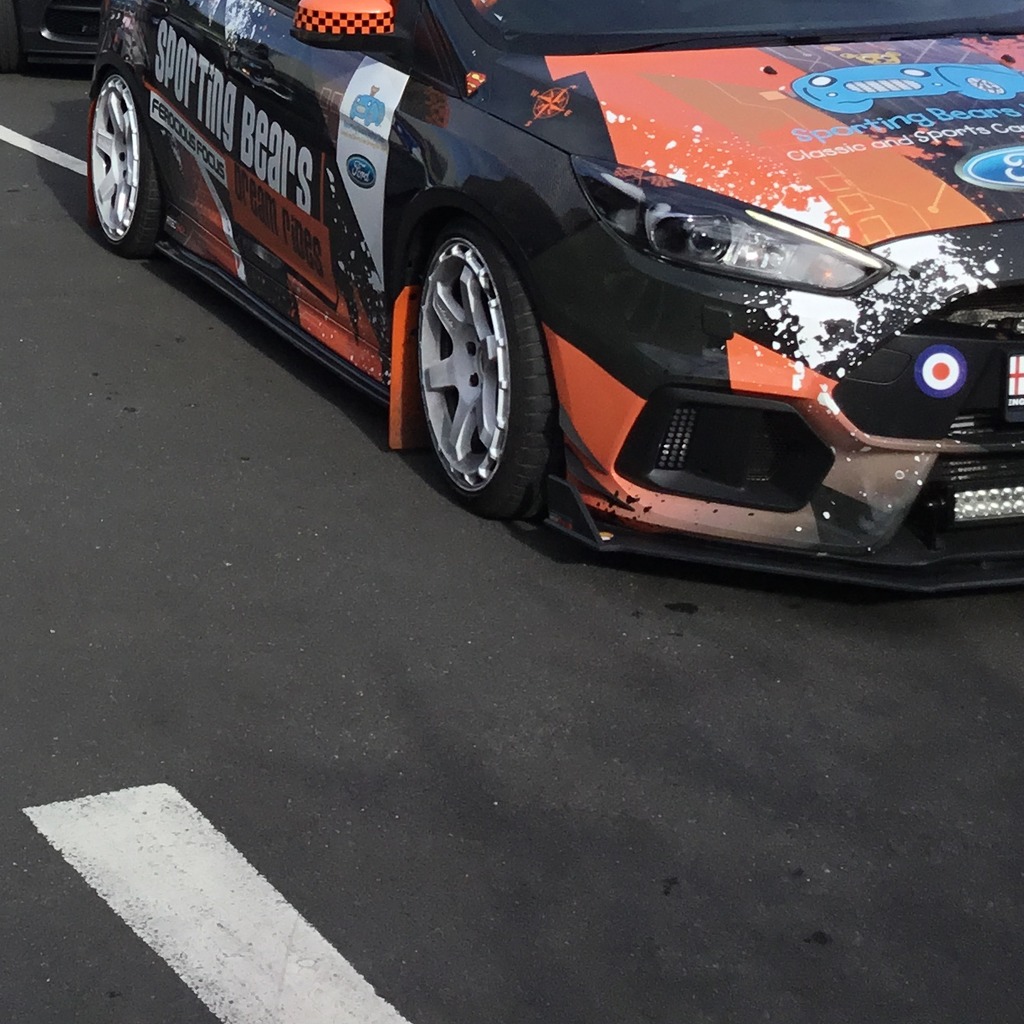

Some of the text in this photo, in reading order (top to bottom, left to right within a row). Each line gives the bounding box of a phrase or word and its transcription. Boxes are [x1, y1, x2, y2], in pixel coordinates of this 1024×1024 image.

[786, 123, 1024, 161] Classic and Sports Ca
[790, 107, 1022, 144] Sporting Bears
